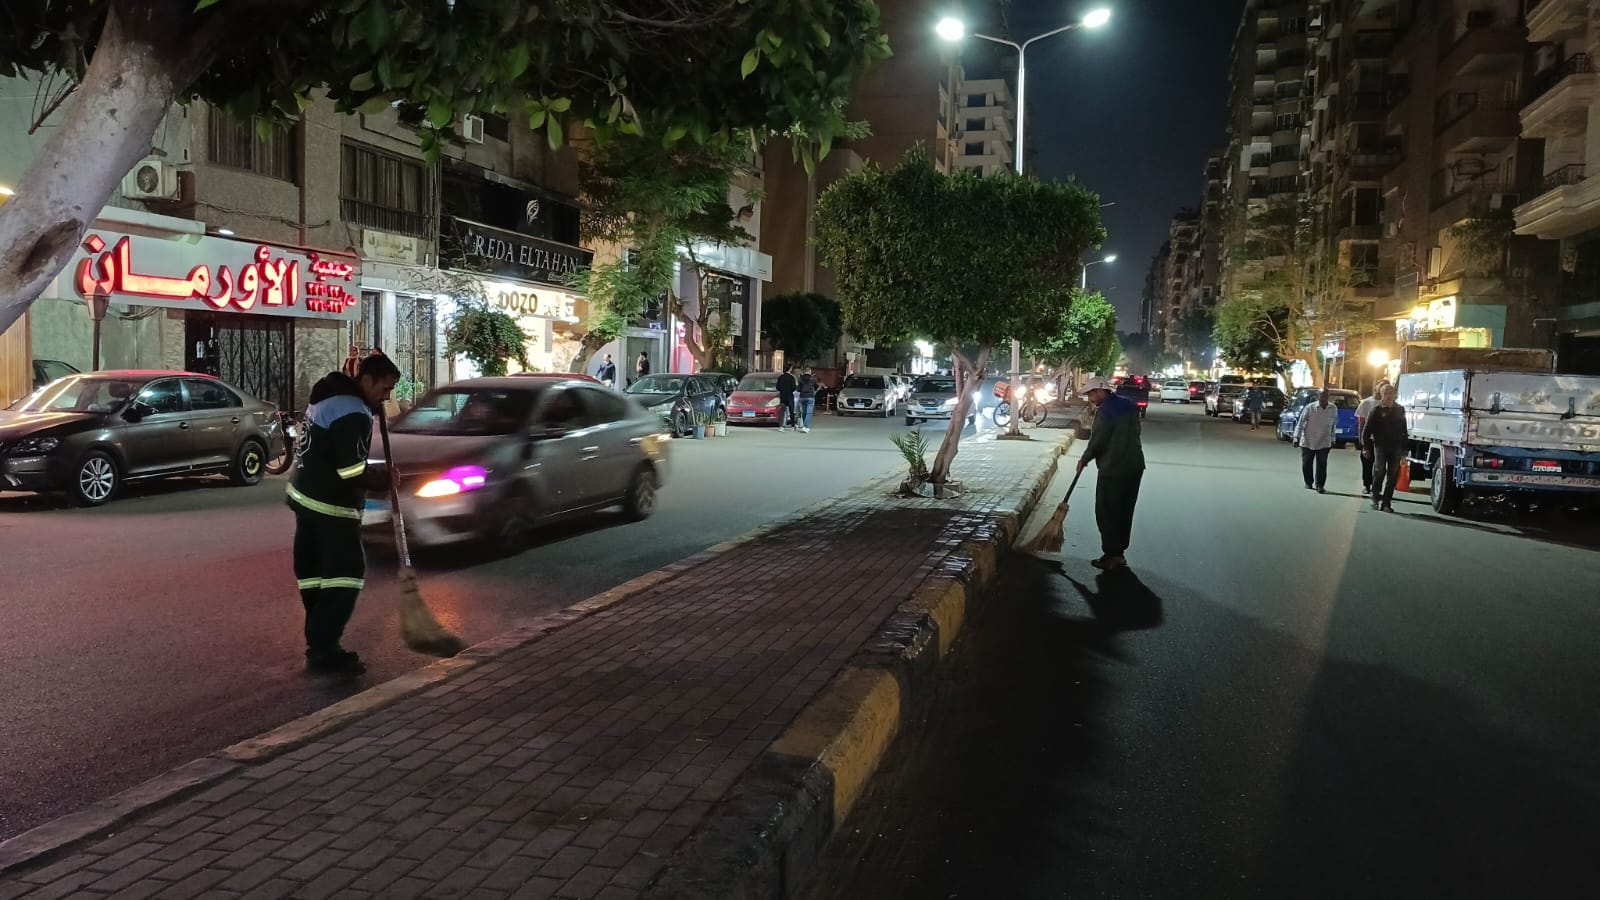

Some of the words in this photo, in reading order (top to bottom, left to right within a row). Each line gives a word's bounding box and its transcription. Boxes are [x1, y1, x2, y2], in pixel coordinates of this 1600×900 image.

[308, 253, 353, 282] جمعية
[475, 235, 514, 262] REDA
[519, 245, 578, 274] ELTAHAN
[74, 234, 298, 310] الأورمان
[499, 290, 538, 314] DOZO
